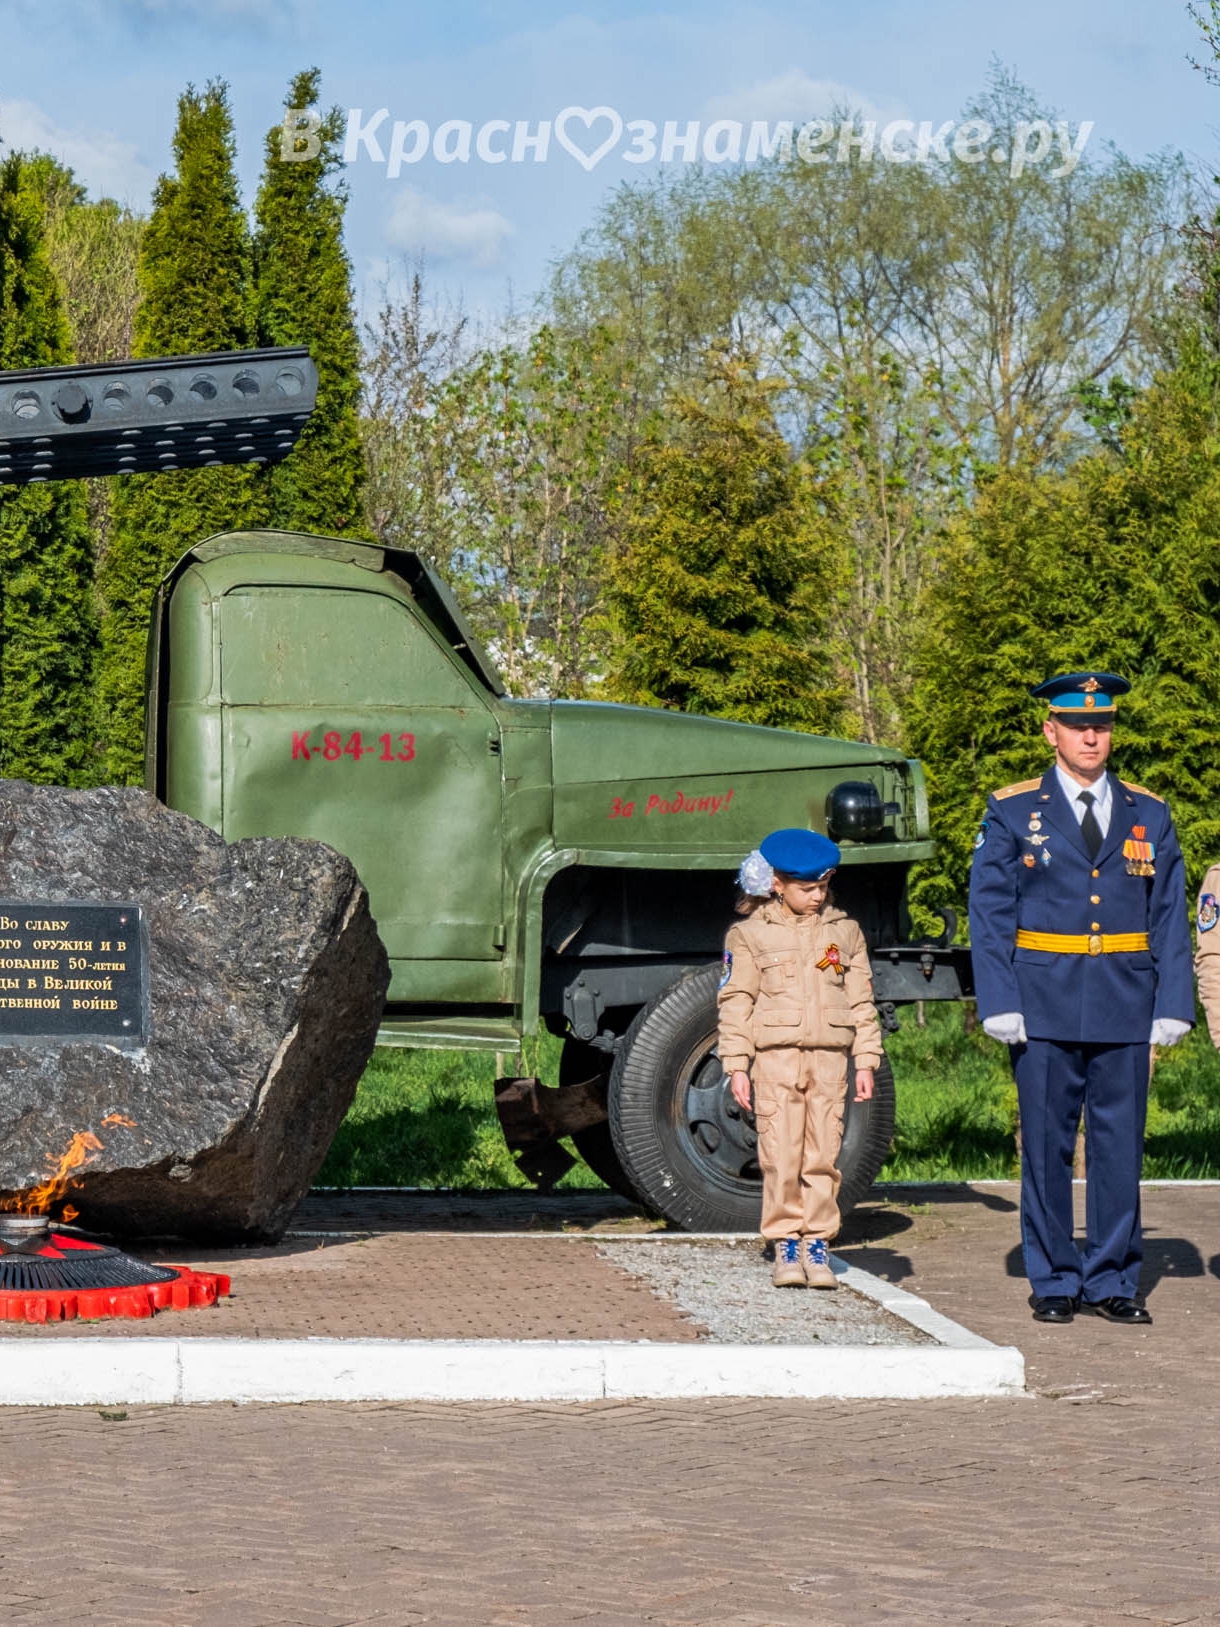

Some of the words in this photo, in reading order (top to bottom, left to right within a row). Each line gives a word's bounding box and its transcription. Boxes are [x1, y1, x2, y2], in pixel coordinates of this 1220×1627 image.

[608, 796, 636, 820] За
[643, 788, 736, 817] Родину!
[0, 915, 19, 931] Во
[43, 975, 113, 992] Великой
